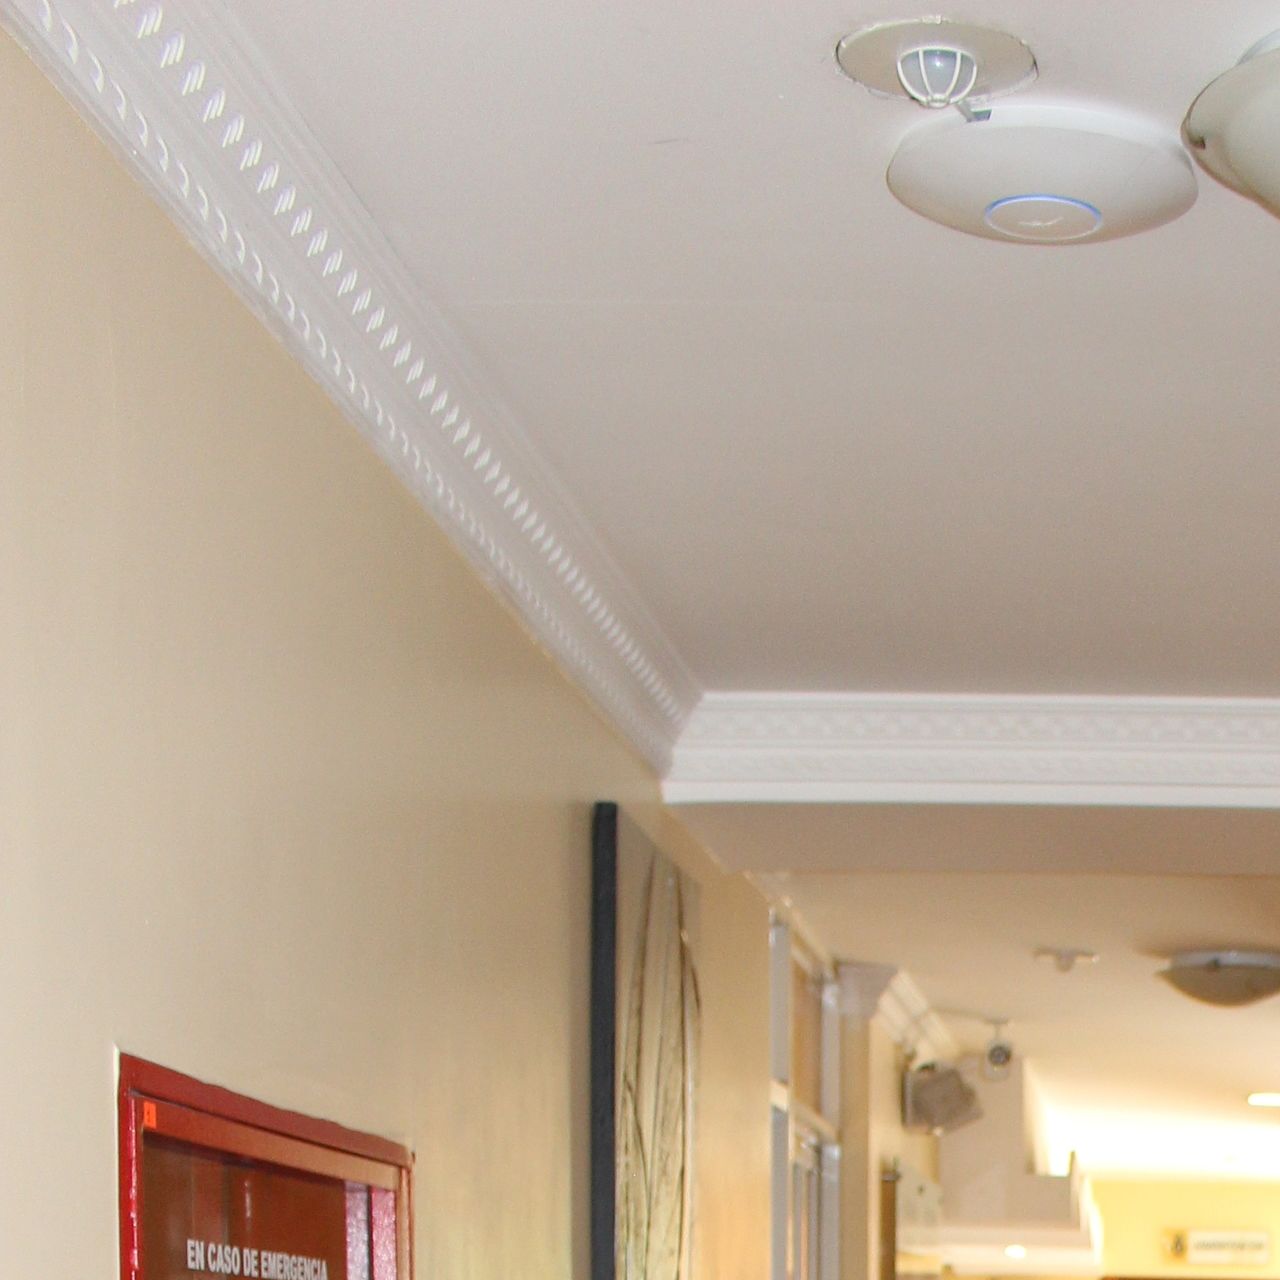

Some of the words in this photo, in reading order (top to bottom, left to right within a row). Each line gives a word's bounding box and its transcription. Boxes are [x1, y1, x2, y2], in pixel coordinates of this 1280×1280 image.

[187, 1239, 205, 1271] EN
[207, 1242, 241, 1276] CASO
[242, 1247, 259, 1278] DE
